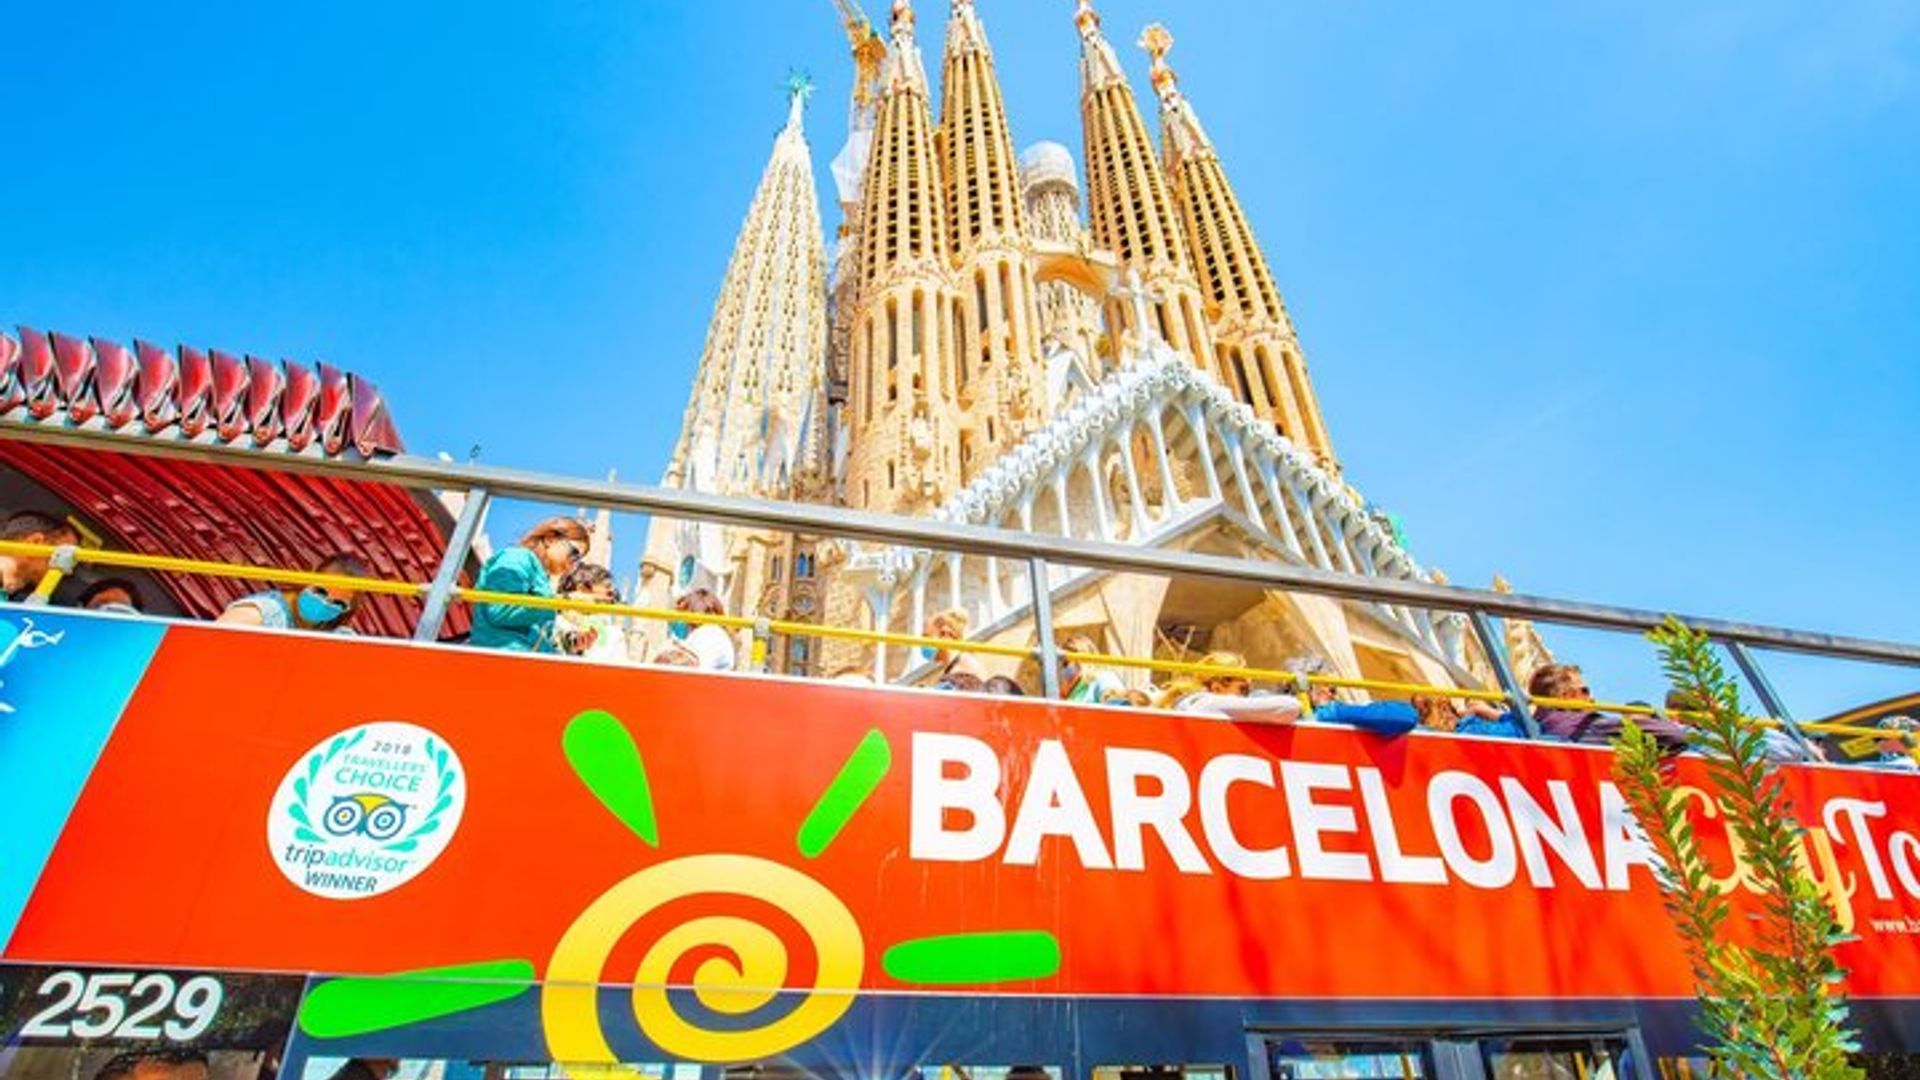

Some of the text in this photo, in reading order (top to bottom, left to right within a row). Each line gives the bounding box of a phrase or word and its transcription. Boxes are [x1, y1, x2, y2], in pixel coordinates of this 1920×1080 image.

[371, 740, 412, 755] 2018
[335, 766, 422, 792] CHOICE
[910, 732, 1684, 891] BARCELONA
[285, 843, 408, 872] tripadvisor
[305, 871, 377, 892] WINNER
[18, 971, 223, 1040] 2529
